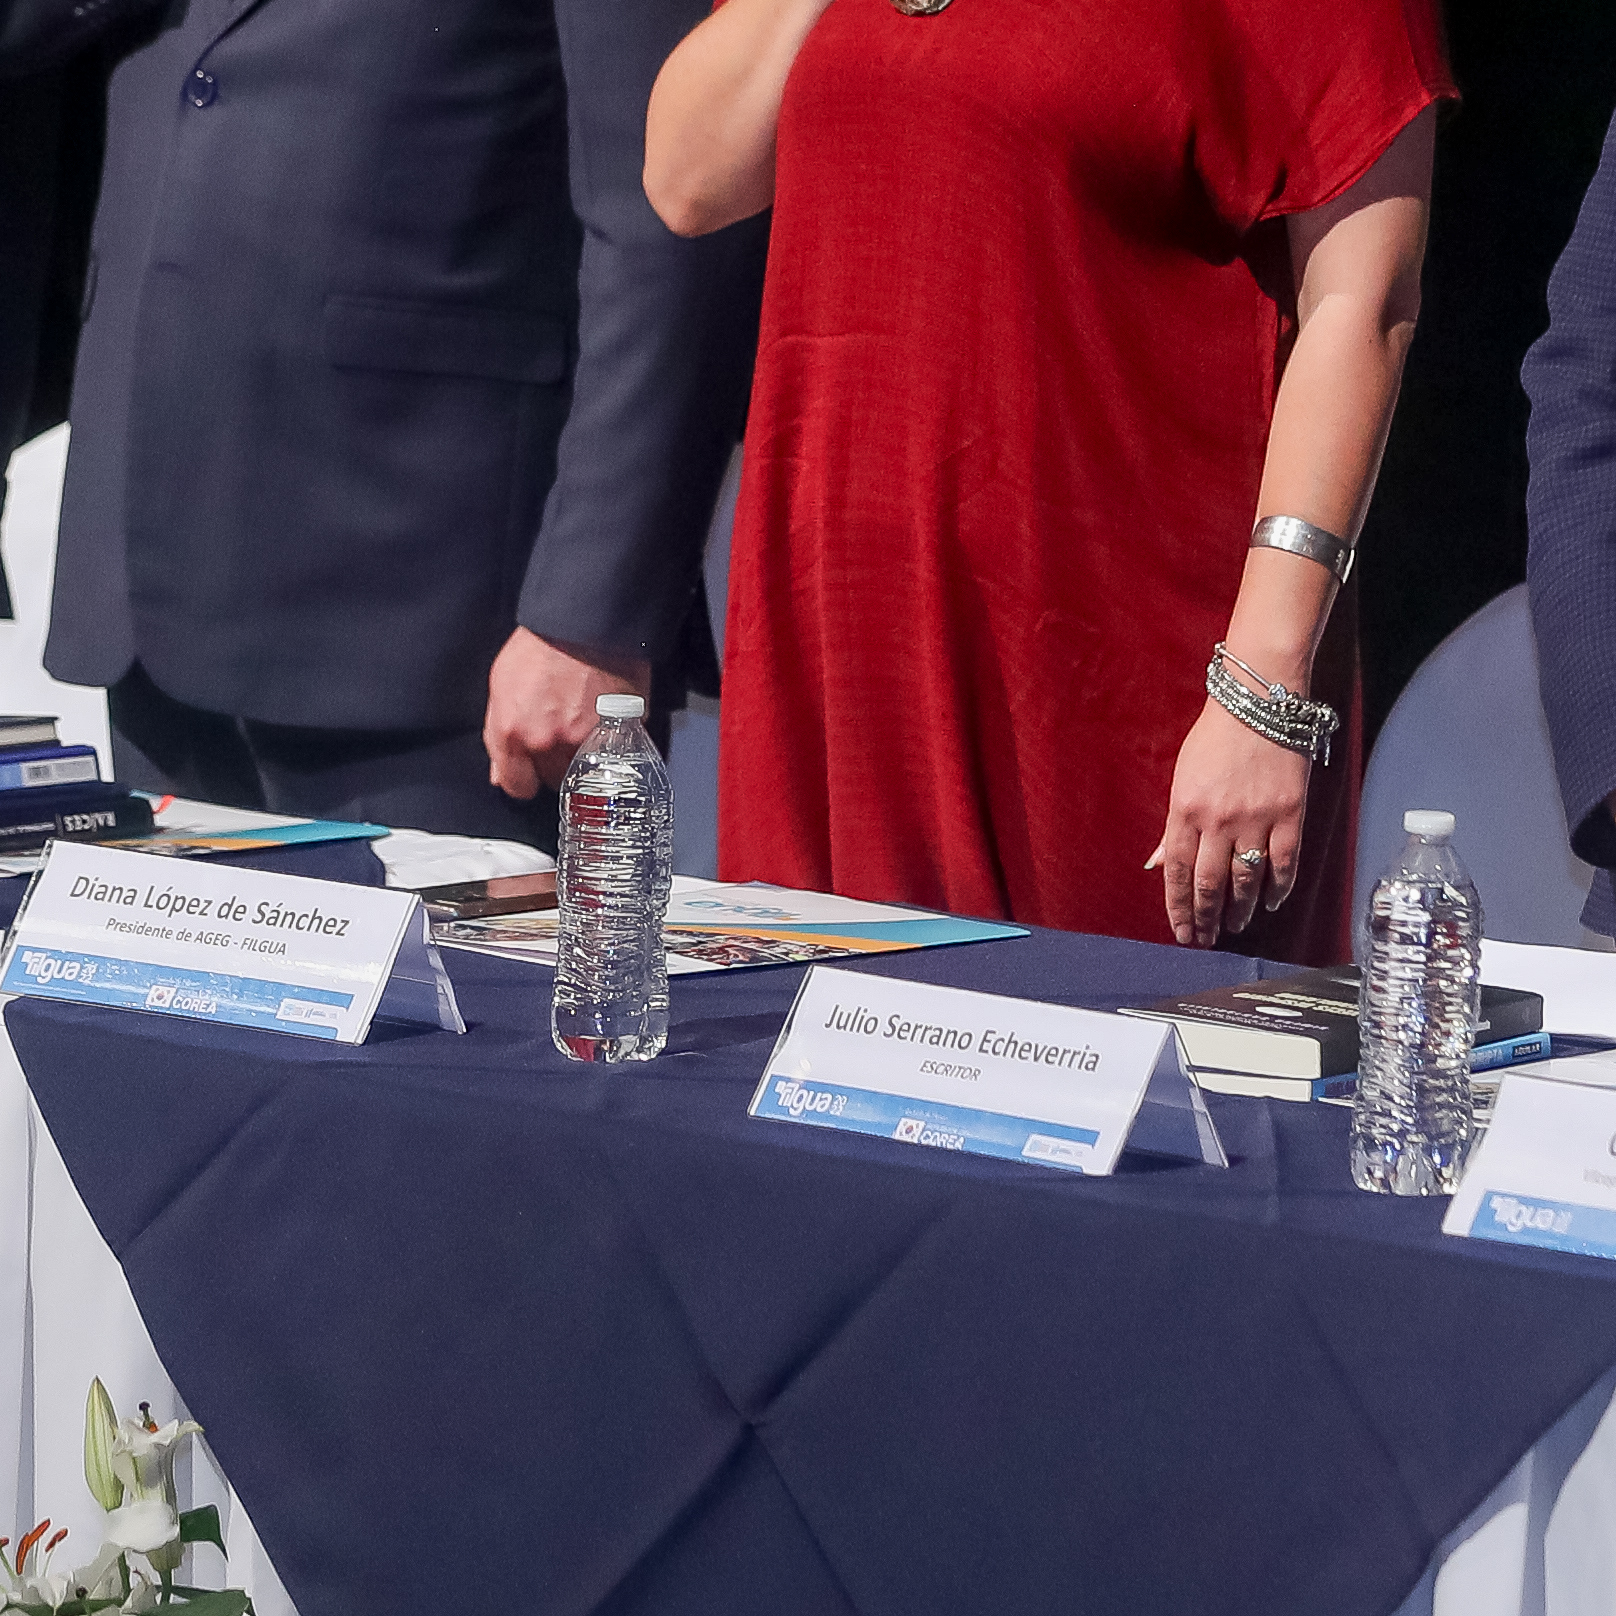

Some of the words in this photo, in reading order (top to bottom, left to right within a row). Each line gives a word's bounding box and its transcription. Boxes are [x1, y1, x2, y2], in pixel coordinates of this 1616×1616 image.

[69, 875, 137, 906] Diana
[143, 885, 212, 917] López
[217, 896, 247, 921] de
[252, 901, 350, 937] Sánchez
[105, 917, 173, 940] Presidente
[176, 927, 192, 942] de
[194, 930, 231, 948] AGEG
[240, 937, 287, 956] FILGUA
[172, 996, 218, 1015] COREA
[824, 1004, 879, 1034] Julio
[883, 1013, 972, 1050] Serrano
[978, 1029, 1100, 1072] Echeverria
[919, 1060, 981, 1082] ESCRITOR
